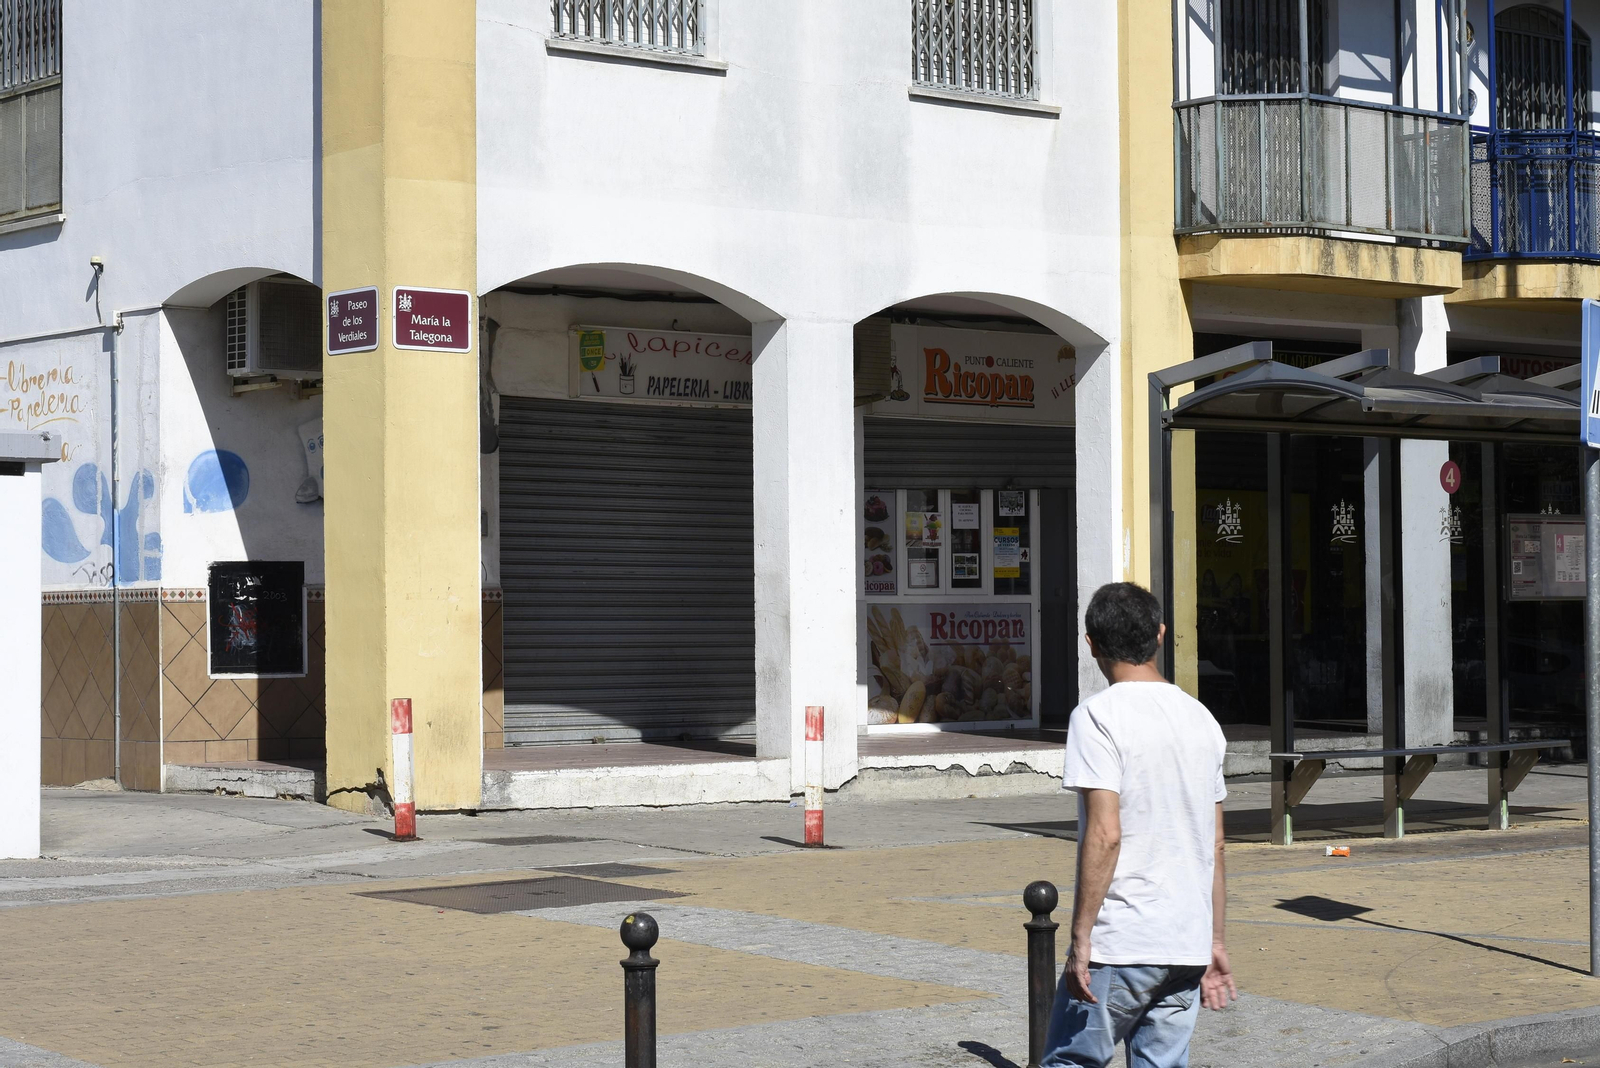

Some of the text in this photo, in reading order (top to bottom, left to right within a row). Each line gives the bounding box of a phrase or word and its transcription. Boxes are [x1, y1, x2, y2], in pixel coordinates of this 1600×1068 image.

[347, 300, 368, 310] Paseo
[342, 315, 363, 327] de los
[411, 314, 451, 327] María la
[338, 330, 367, 343] Verdiales
[409, 329, 453, 344] Talegona
[586, 347, 602, 356] ONCE
[996, 357, 1035, 369] CALIENTE
[923, 347, 1035, 407] Ricopan
[647, 375, 710, 398] PAPELERIA
[1445, 467, 1456, 488] 4
[993, 536, 1019, 544] CURSOS
[929, 611, 1026, 643] Ricopan
